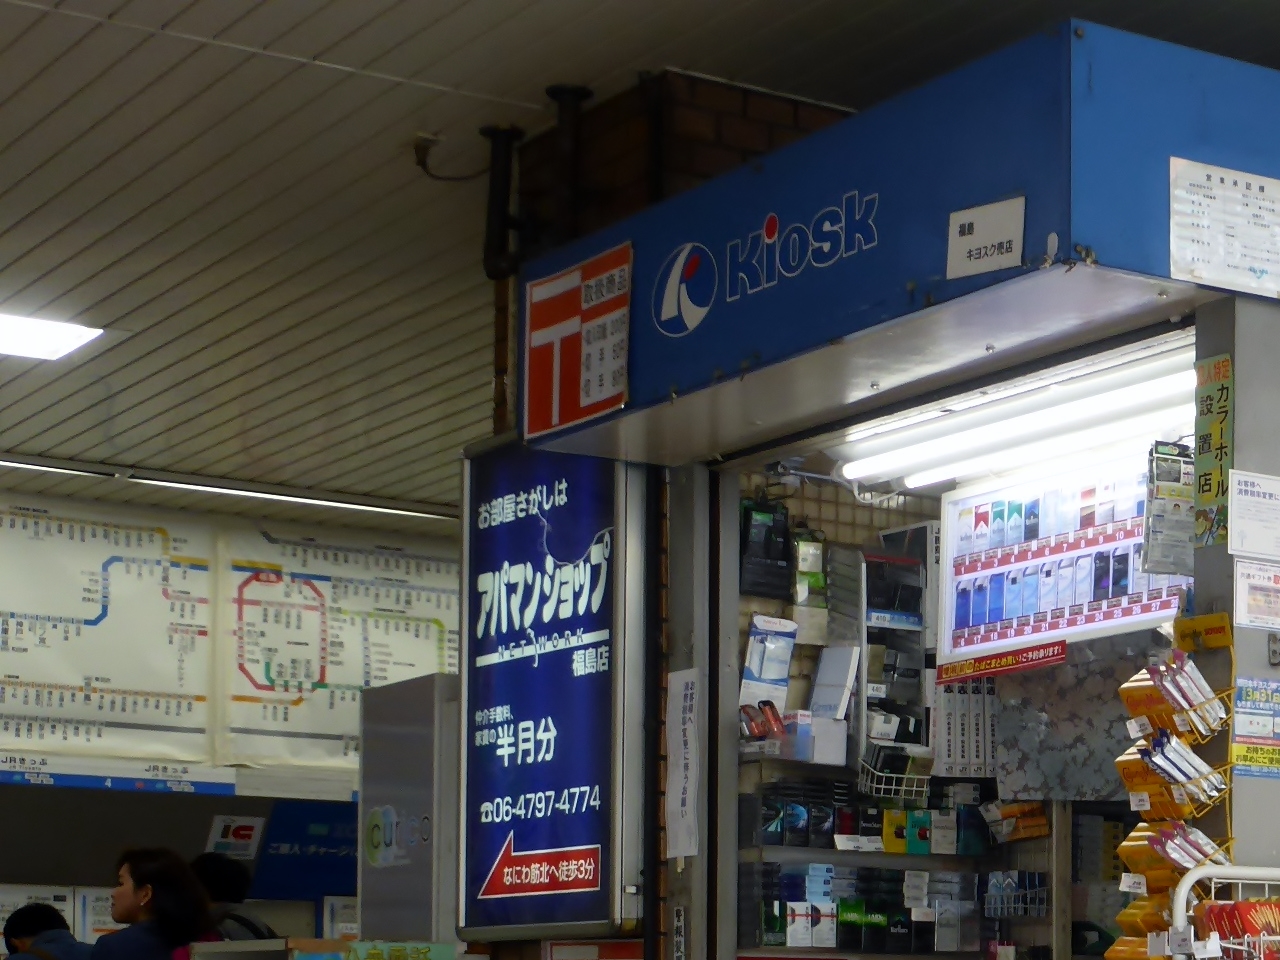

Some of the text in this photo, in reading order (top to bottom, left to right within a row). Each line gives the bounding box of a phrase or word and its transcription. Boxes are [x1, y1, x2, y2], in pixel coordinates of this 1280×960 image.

[726, 190, 879, 303] Kiosk
[966, 240, 1015, 263] キヨスク売店
[1197, 395, 1215, 495] 設置店
[477, 477, 569, 530] お部屋さがしは
[476, 531, 611, 640] アパマンショップ
[572, 645, 610, 677] 福島店
[503, 857, 595, 885] なにわ筋北へ徒歩3分
